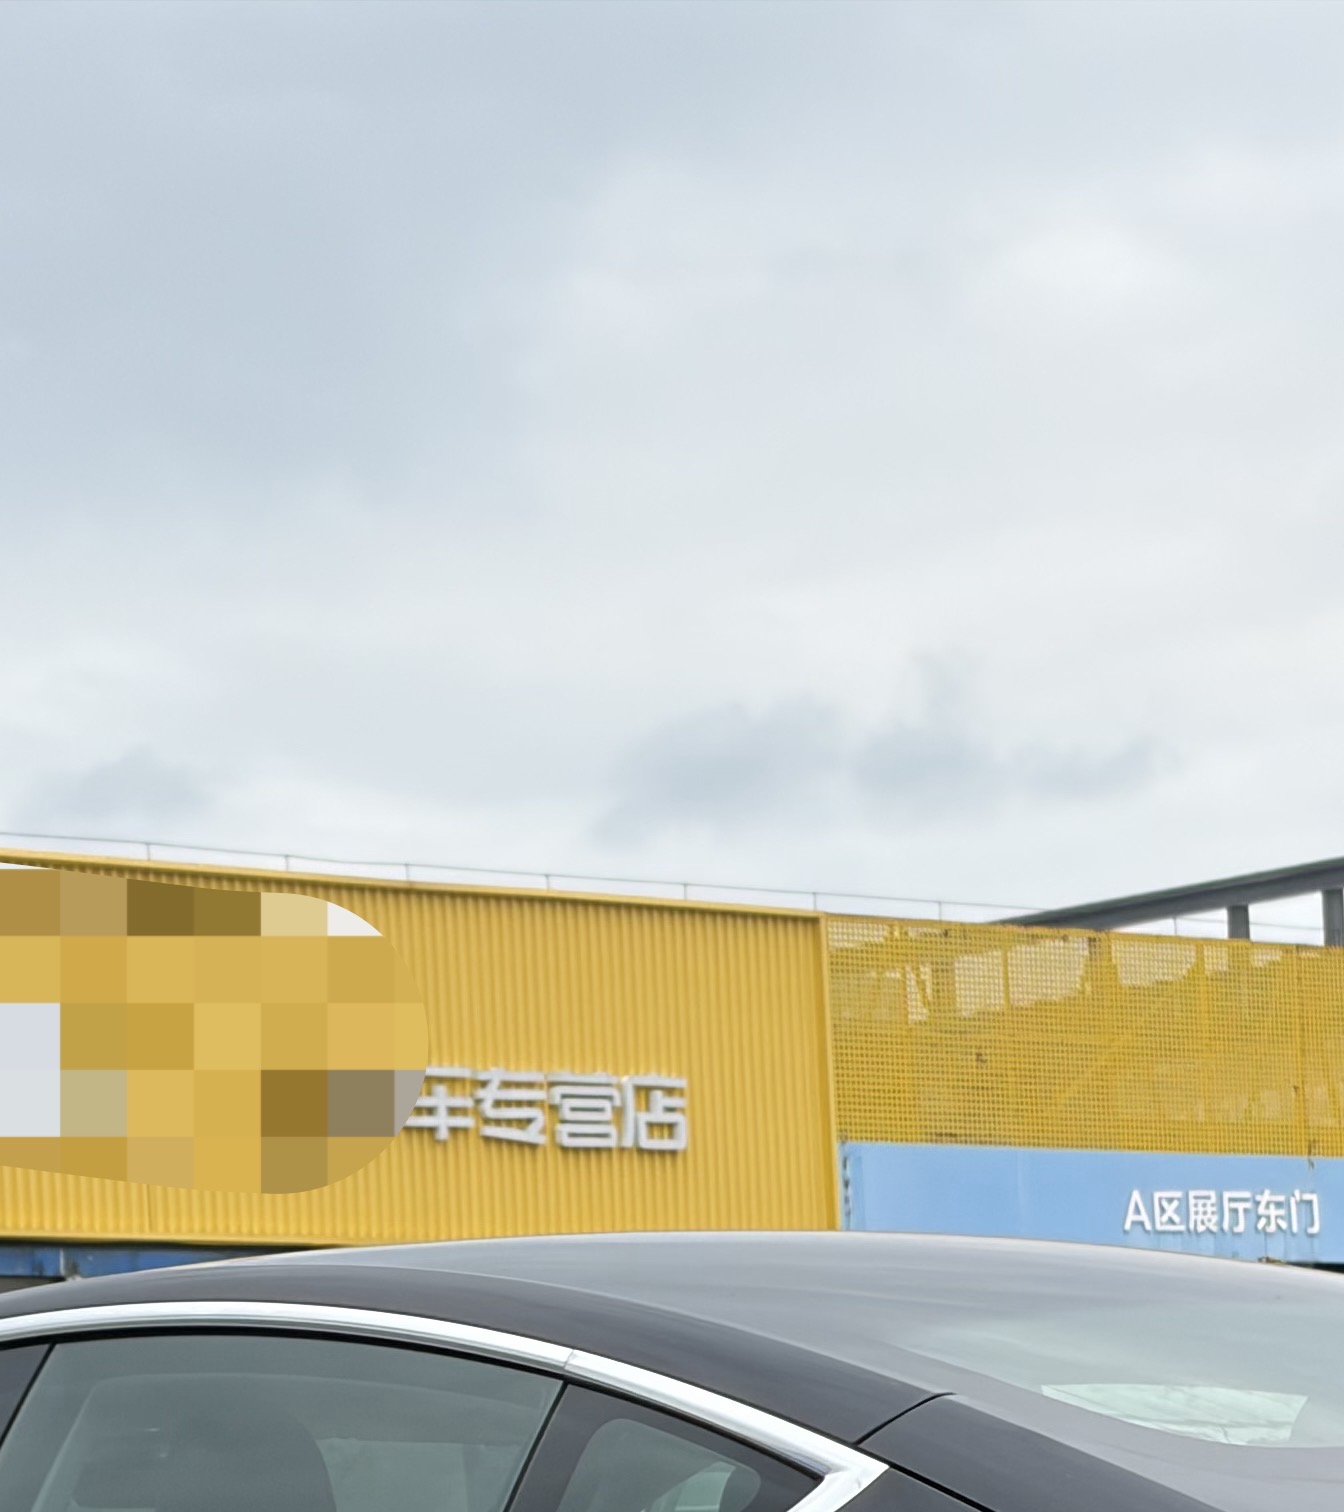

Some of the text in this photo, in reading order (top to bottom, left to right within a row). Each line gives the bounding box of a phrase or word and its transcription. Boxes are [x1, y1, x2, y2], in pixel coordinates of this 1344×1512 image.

[1123, 1188, 1321, 1235] A区展厅东门
